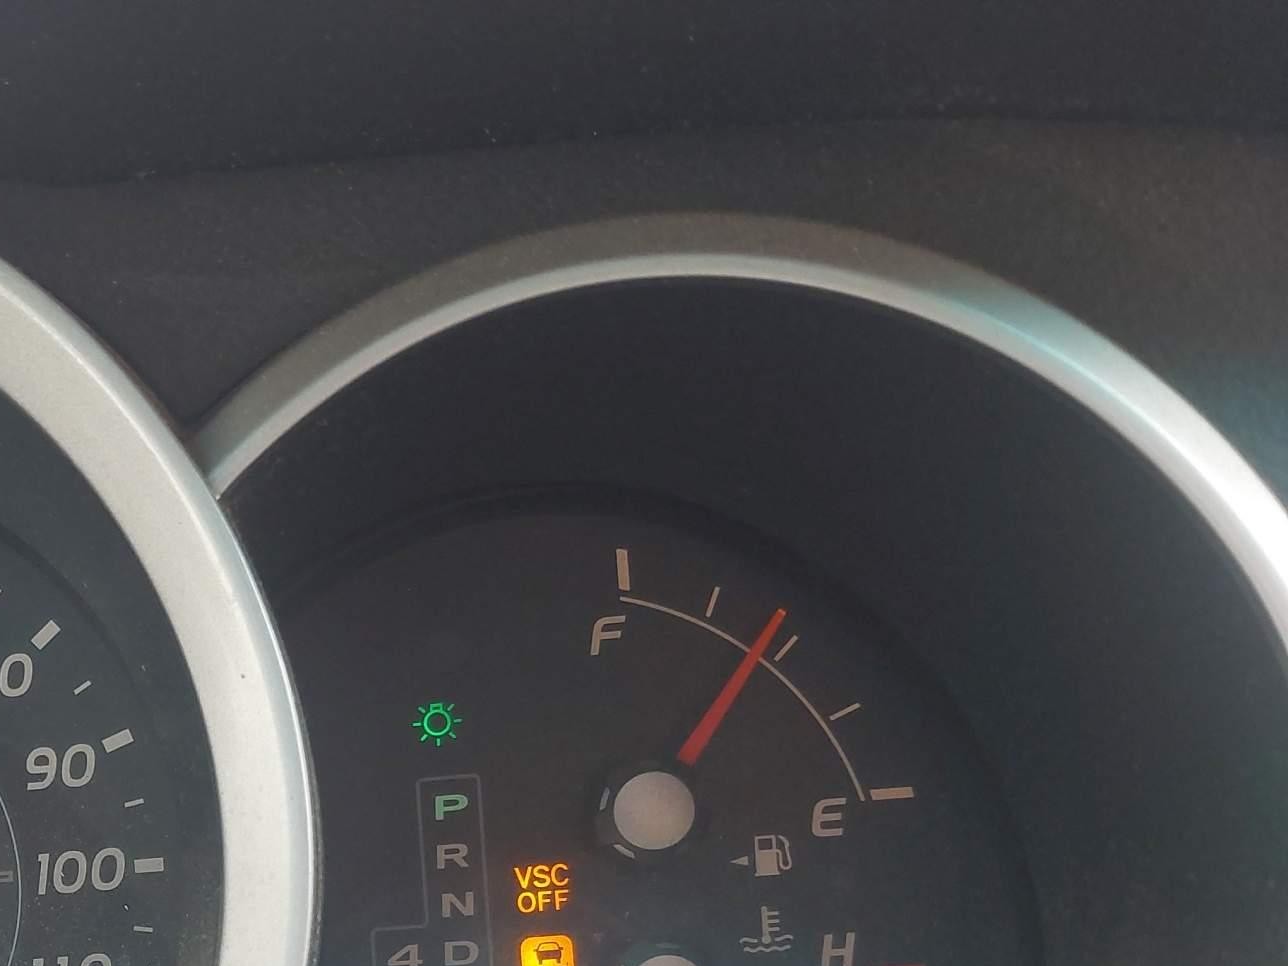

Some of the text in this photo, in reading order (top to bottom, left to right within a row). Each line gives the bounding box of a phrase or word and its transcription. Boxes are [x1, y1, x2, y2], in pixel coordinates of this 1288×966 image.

[590, 615, 626, 656] F
[25, 743, 96, 791] 90
[434, 794, 469, 821] P
[812, 797, 847, 838] E
[437, 843, 469, 869] R
[36, 847, 126, 895] 100
[515, 864, 569, 889] VSC
[441, 892, 475, 917] N
[517, 889, 569, 914] OFF
[444, 941, 479, 966] D
